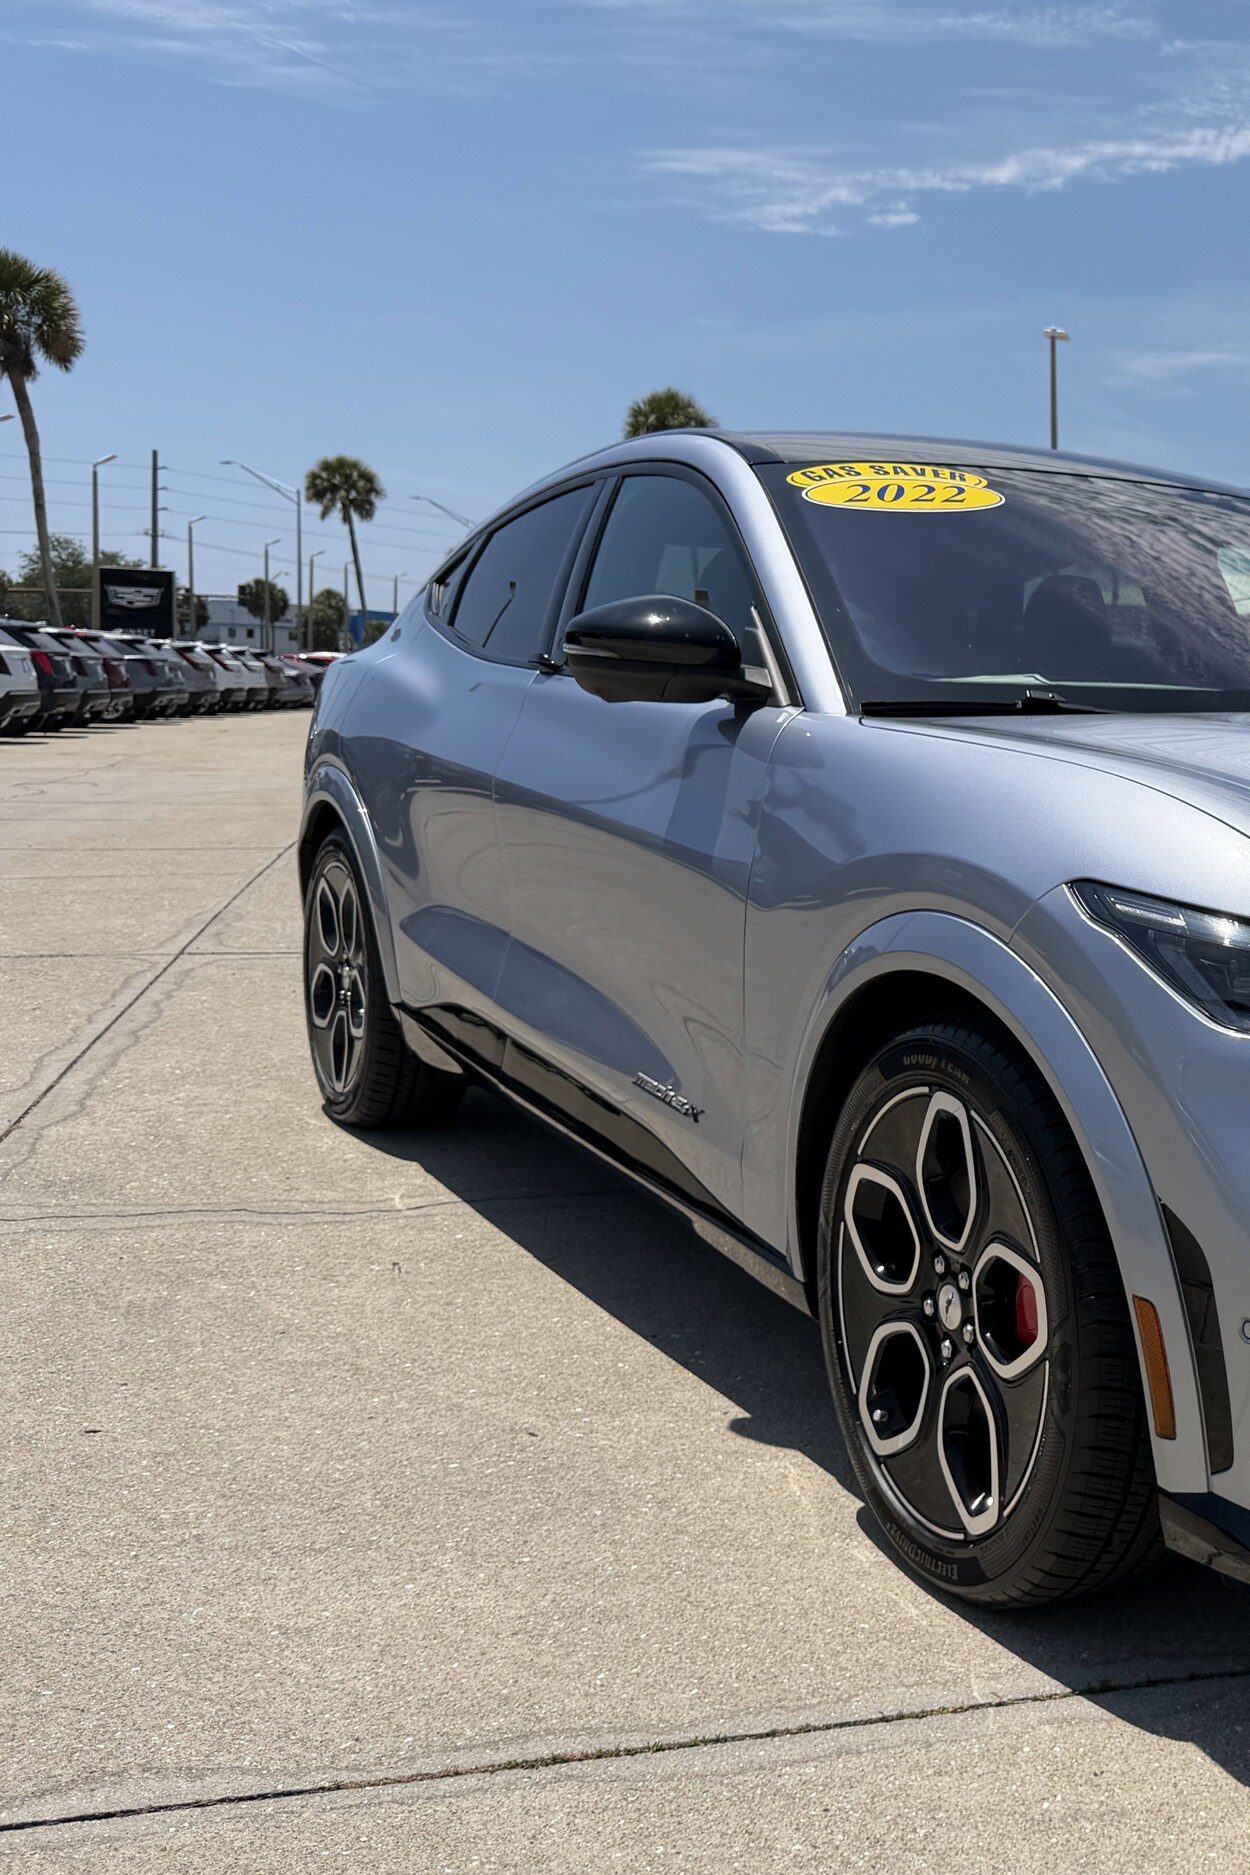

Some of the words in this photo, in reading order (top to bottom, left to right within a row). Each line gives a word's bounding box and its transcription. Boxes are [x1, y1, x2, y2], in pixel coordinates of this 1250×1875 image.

[802, 465, 862, 482] GAS
[867, 464, 967, 483] SAVER
[843, 484, 967, 503] 2022
